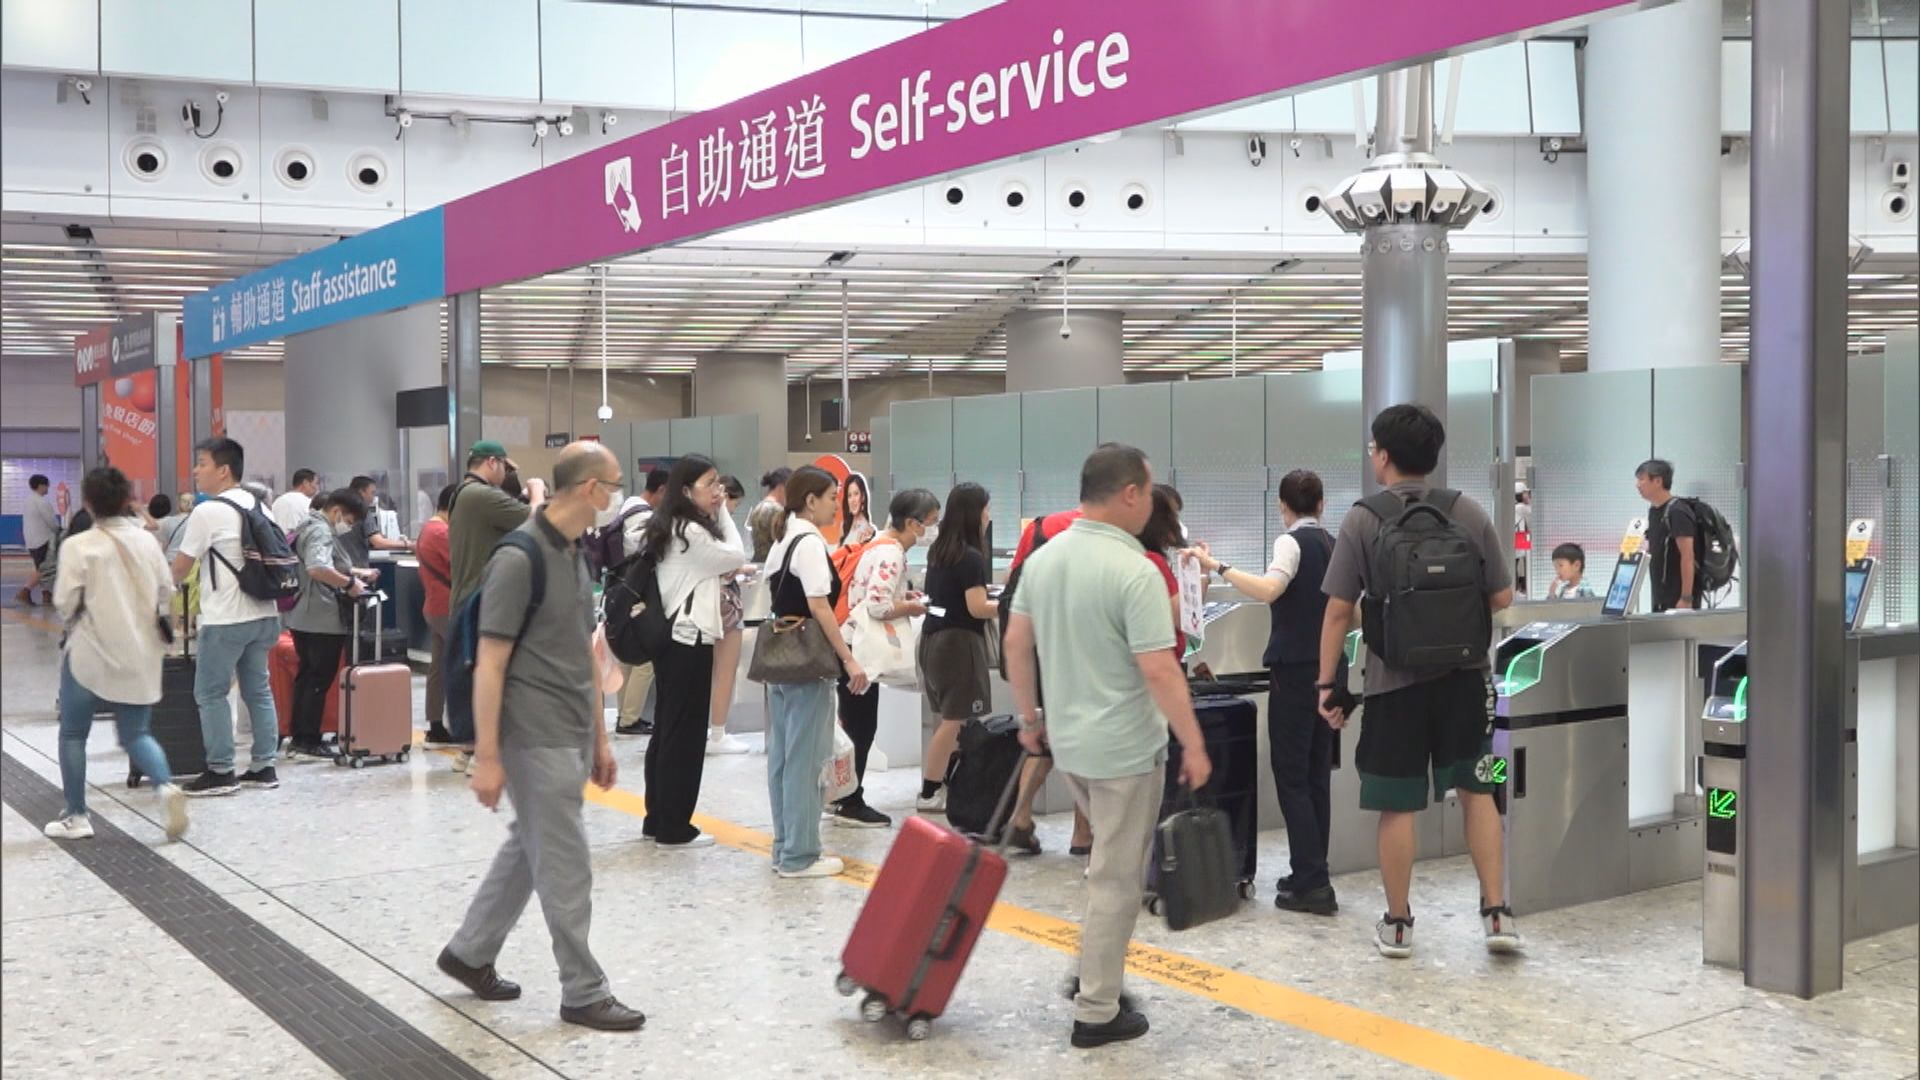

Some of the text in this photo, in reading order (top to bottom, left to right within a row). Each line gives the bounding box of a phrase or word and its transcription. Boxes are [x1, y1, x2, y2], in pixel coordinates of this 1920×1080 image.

[660, 93, 828, 220] 自助通道
[849, 29, 1130, 161] Self-service
[290, 257, 397, 315] Staff assistance
